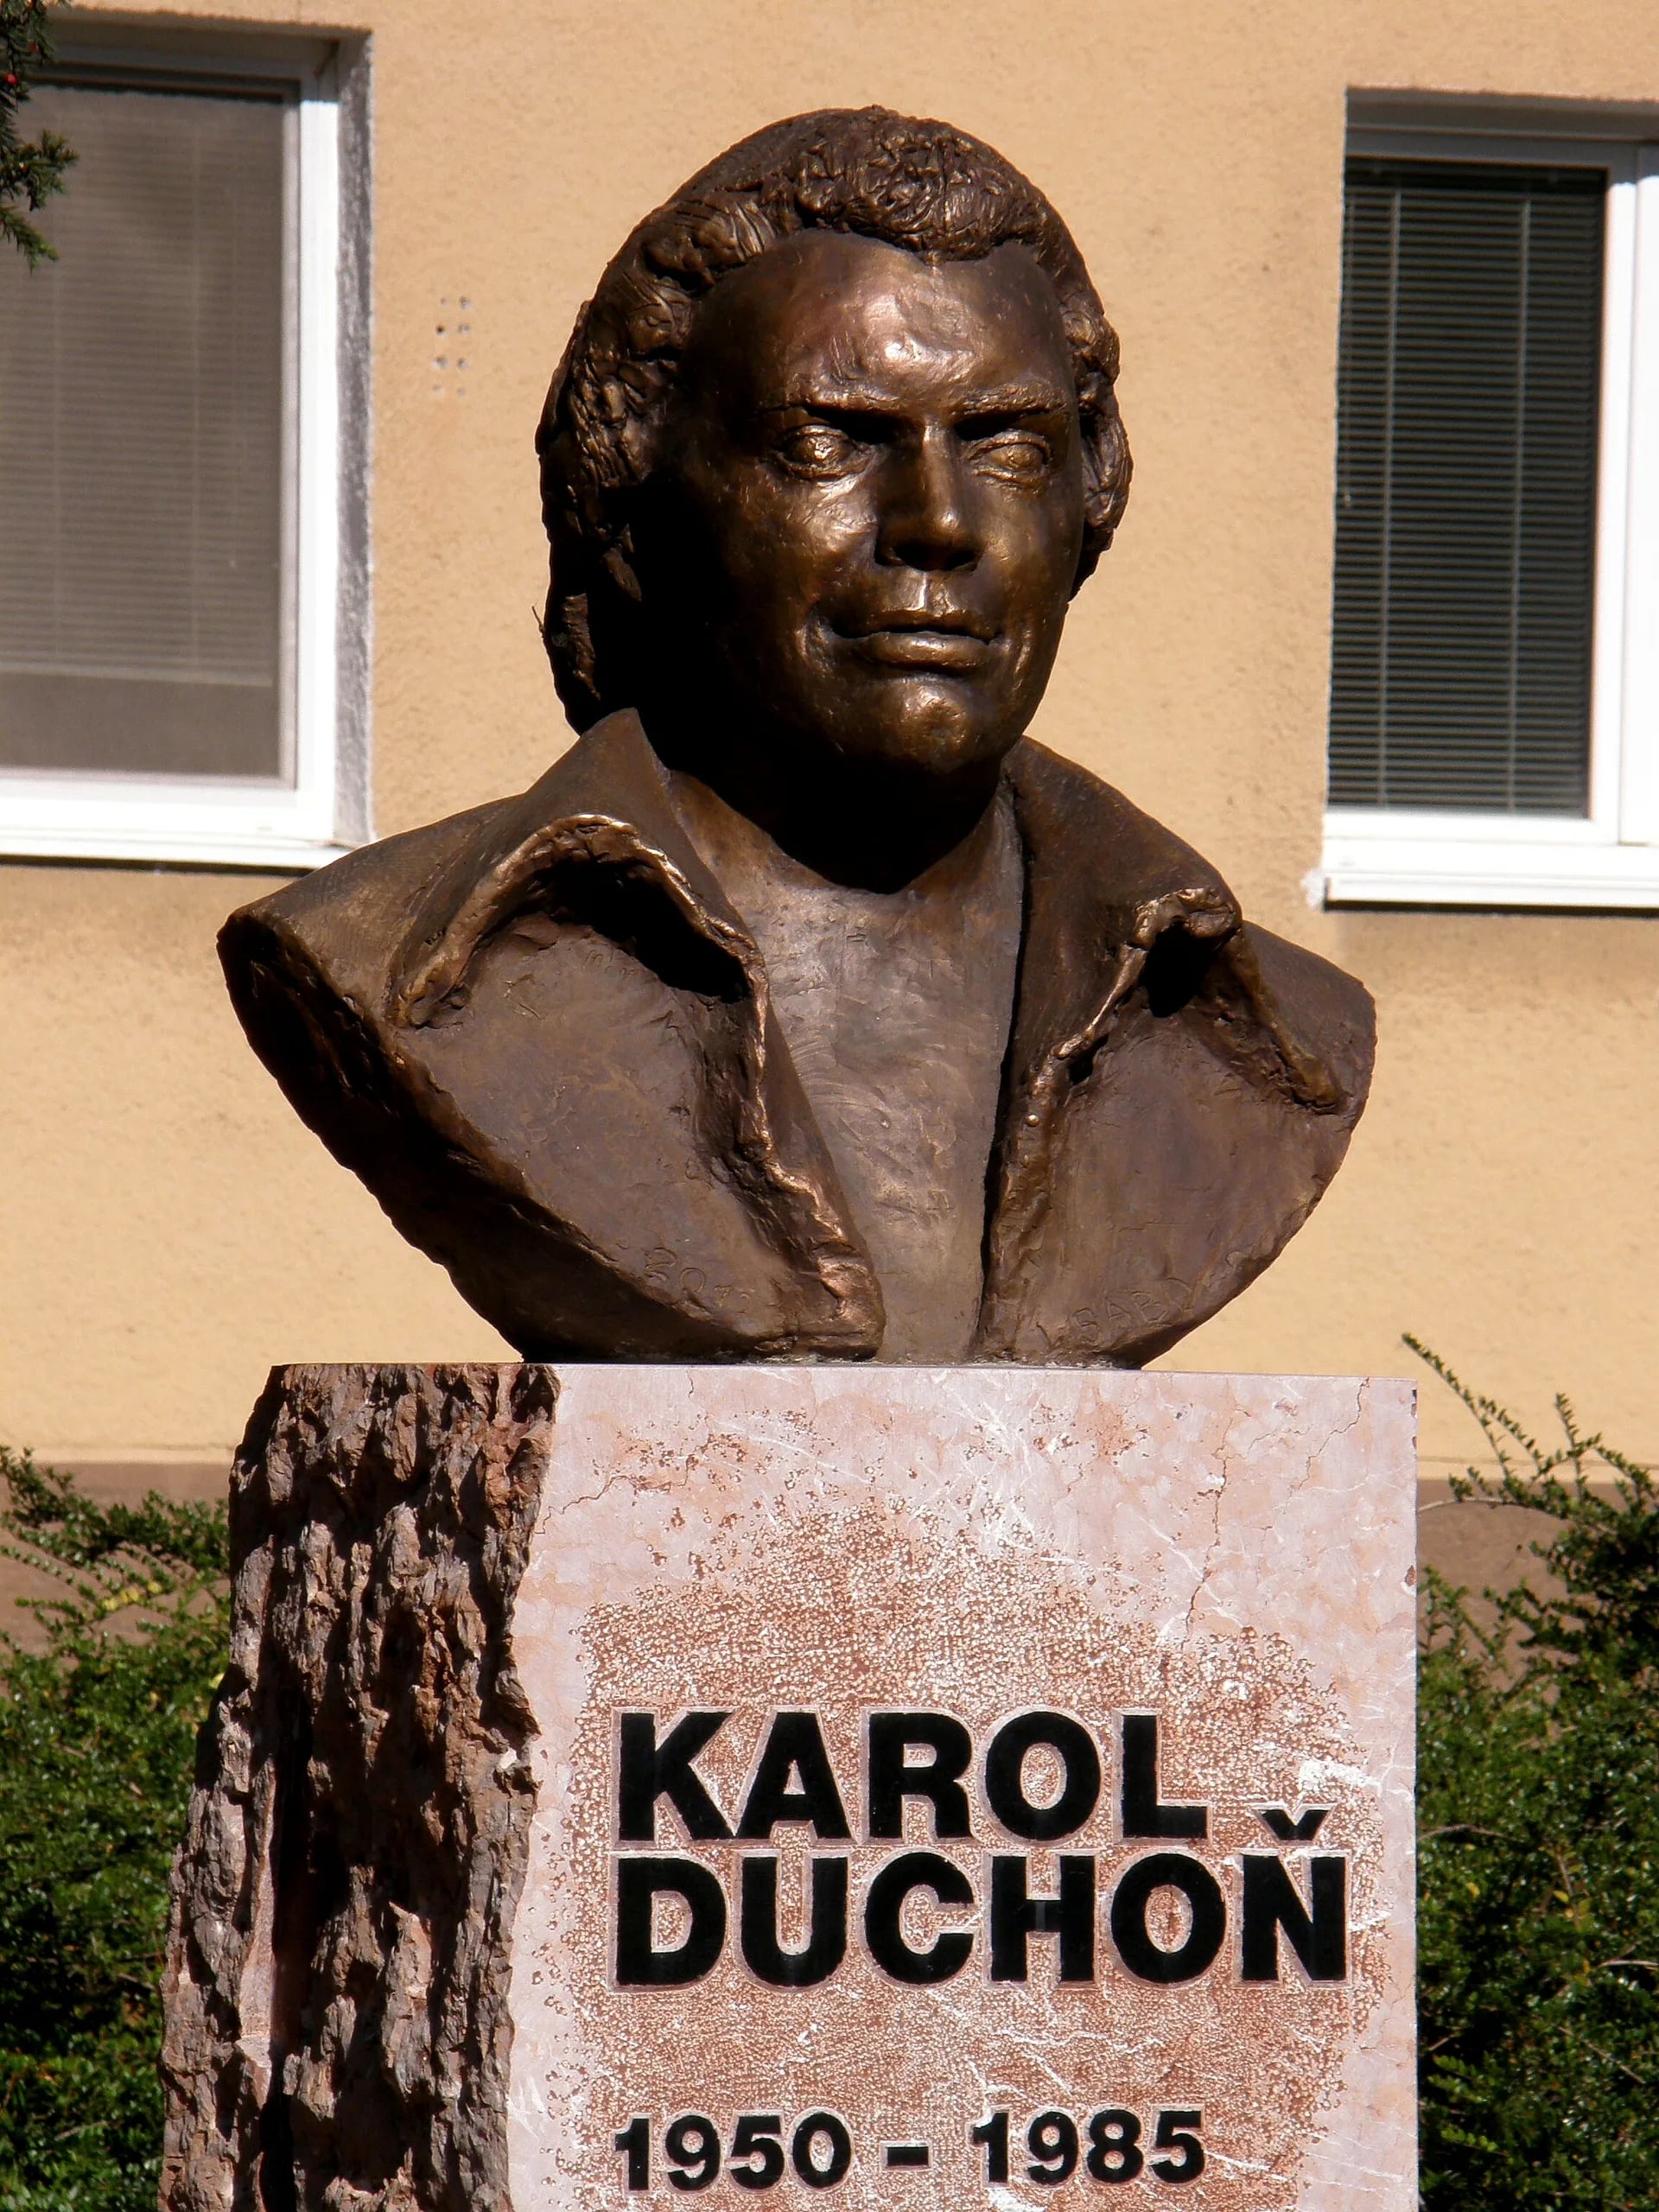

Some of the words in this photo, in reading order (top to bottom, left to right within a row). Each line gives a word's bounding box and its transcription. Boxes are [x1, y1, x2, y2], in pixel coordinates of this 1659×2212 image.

[617, 1710, 1210, 1846] KAROL
[614, 1808, 1347, 1989] DUCHOŇ
[613, 2110, 853, 2192] 1950
[886, 2145, 930, 2168] -
[971, 2108, 1206, 2187] 1985
